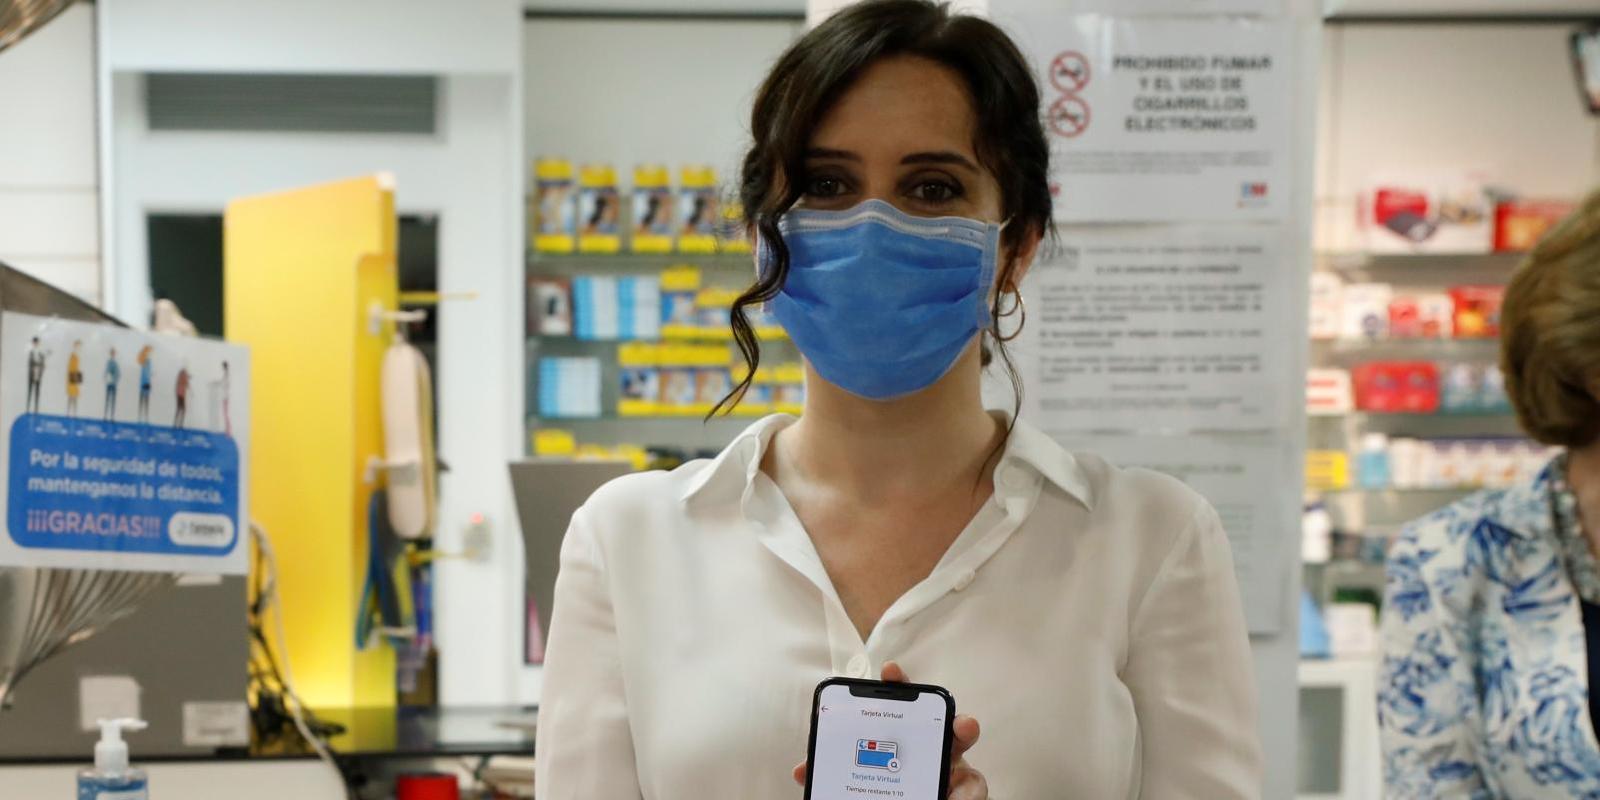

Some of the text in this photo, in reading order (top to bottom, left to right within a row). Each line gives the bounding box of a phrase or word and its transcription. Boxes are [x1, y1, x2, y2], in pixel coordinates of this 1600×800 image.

[1112, 55, 1273, 71] PROHIBIDO FUMAR
[1138, 76, 1243, 91] Y EL USO DE
[1133, 97, 1249, 112] CIGARRILLOS
[29, 448, 224, 483] Por la seguridad de todos,
[28, 476, 138, 499] mantengamos
[140, 481, 155, 500] la
[861, 710, 904, 719] Tarjeta Virtual
[852, 772, 901, 783] Tarjeta Virtual
[845, 785, 867, 793] Tiempo
